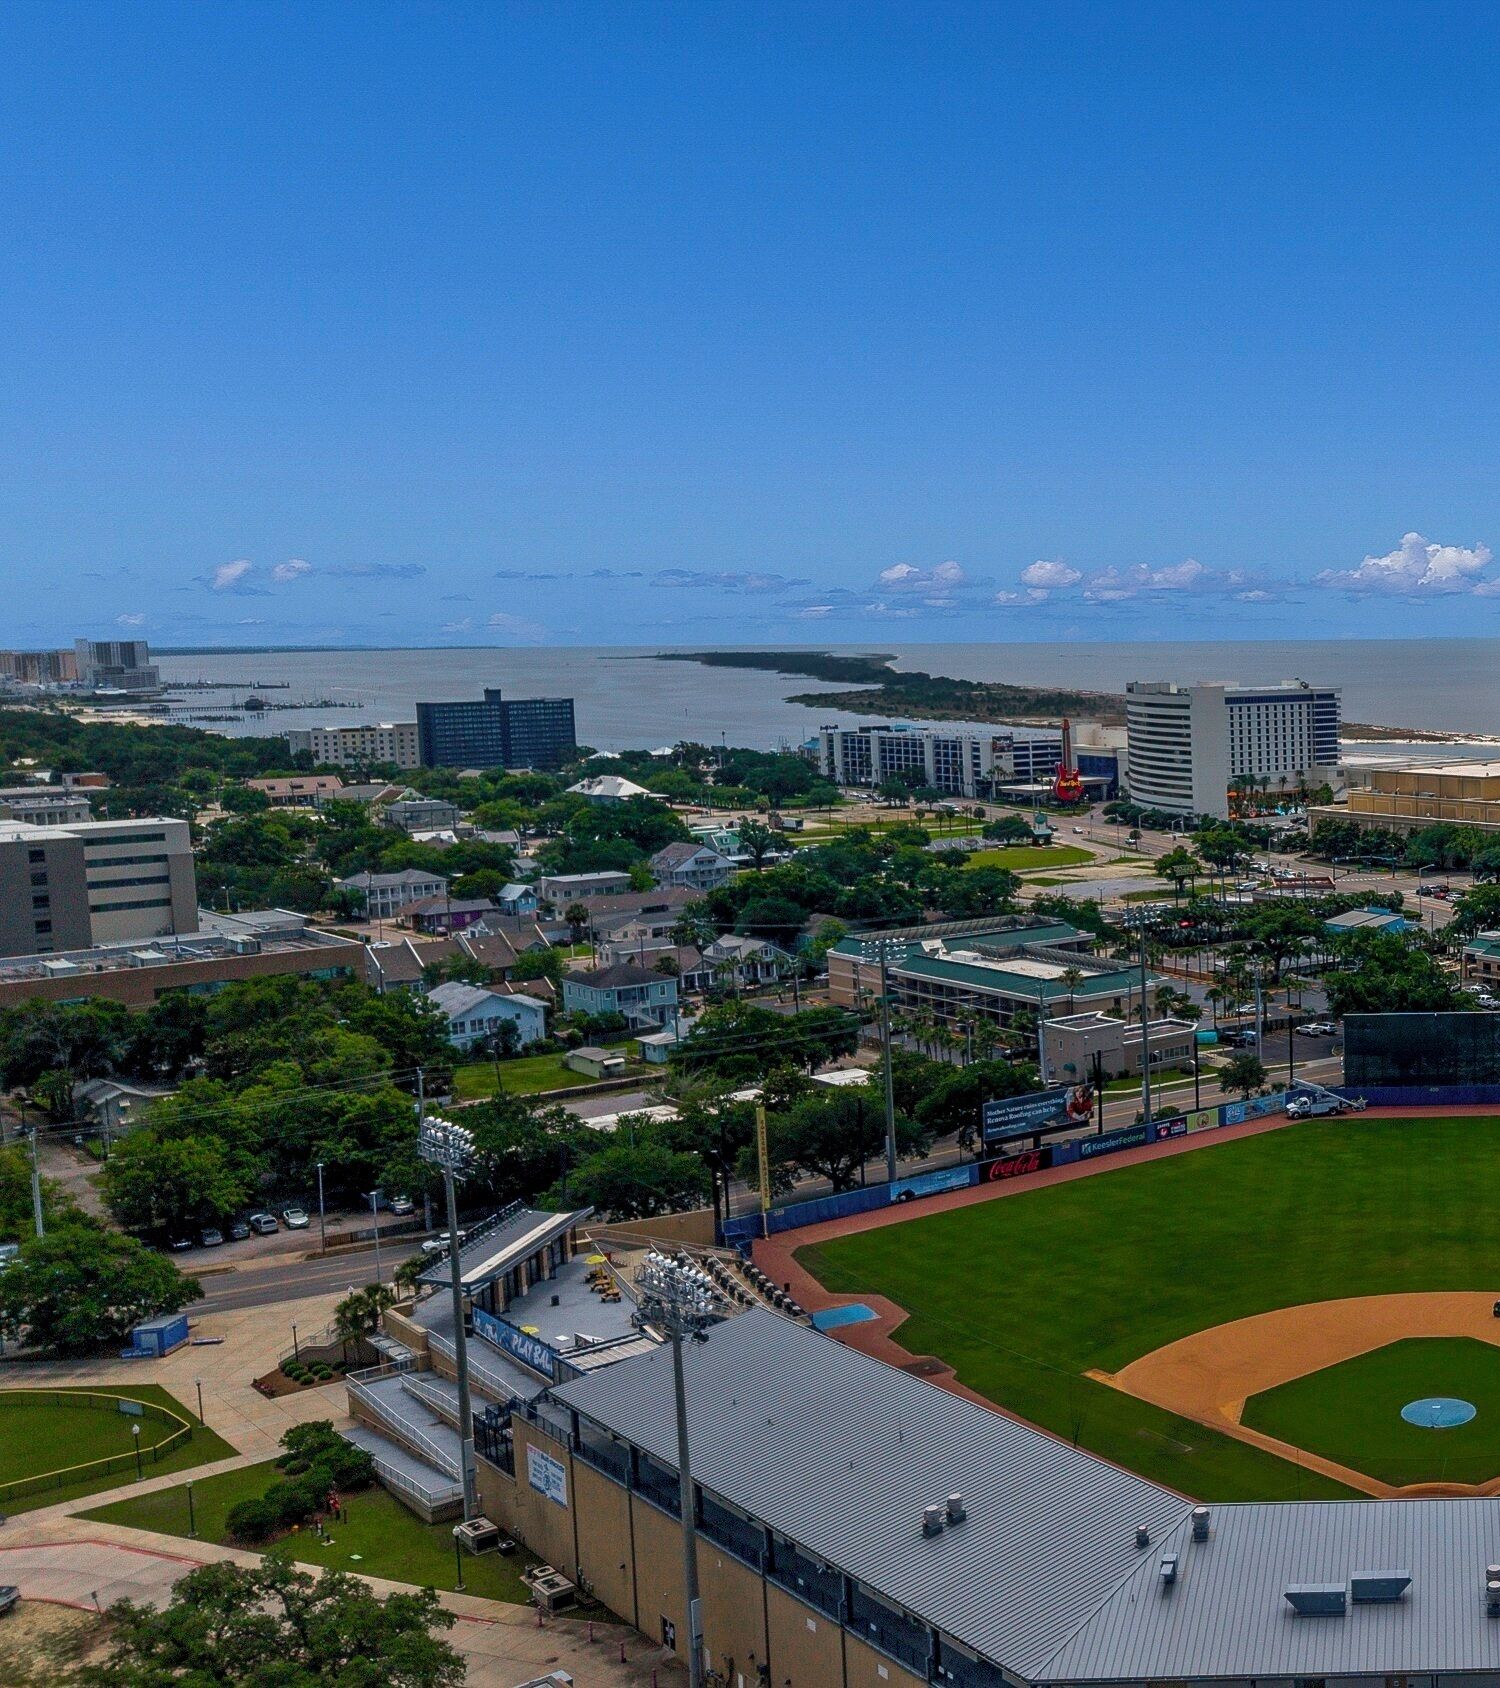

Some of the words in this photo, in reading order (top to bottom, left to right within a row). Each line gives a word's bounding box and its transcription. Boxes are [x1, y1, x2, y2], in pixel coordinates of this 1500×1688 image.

[986, 1109, 1006, 1117] Mother
[1007, 1105, 1023, 1113] Nature
[1009, 1111, 1031, 1120] Roofing
[511, 1334, 533, 1360] PLAY
